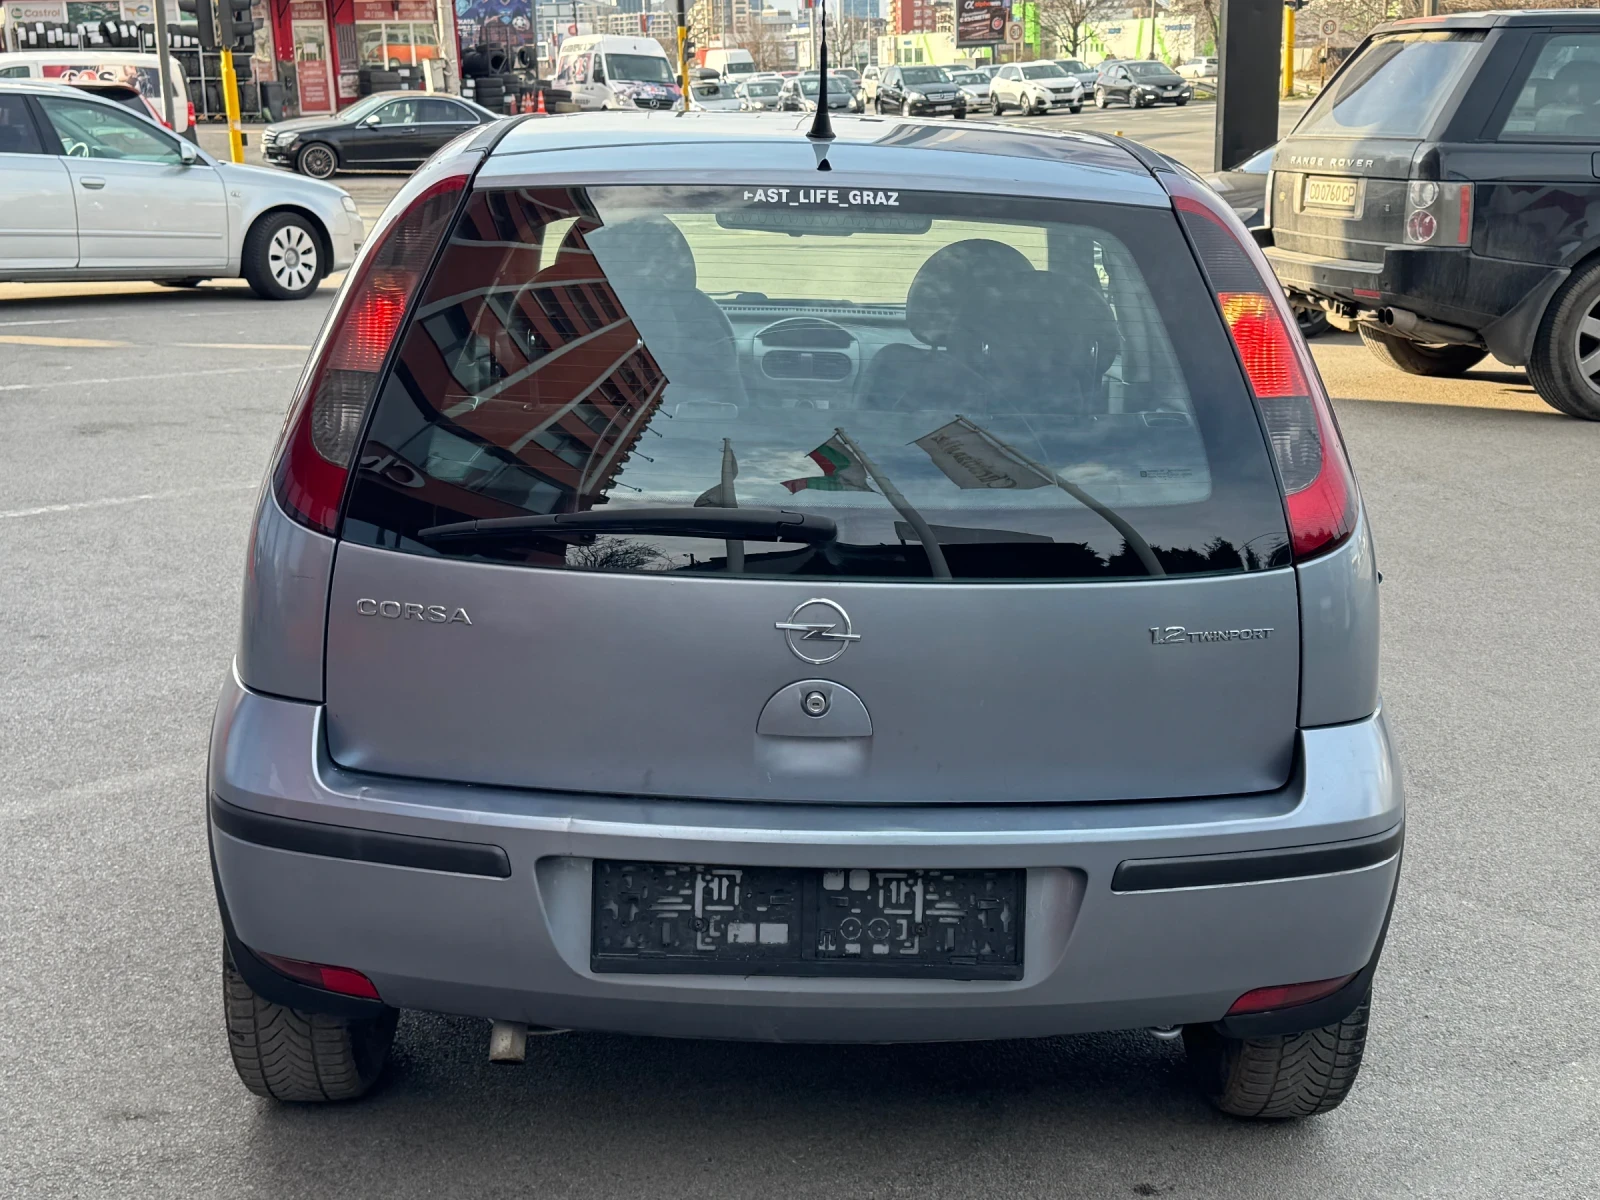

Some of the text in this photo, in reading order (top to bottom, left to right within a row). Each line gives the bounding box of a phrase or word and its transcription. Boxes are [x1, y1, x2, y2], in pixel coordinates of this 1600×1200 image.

[24, 8, 60, 18] Castrol
[1290, 156, 1374, 168] RANGE ROVER
[1321, 184, 1341, 201] 0760
[356, 598, 473, 626] CORSA
[1149, 626, 1274, 644] 1.2 TWINPORT
